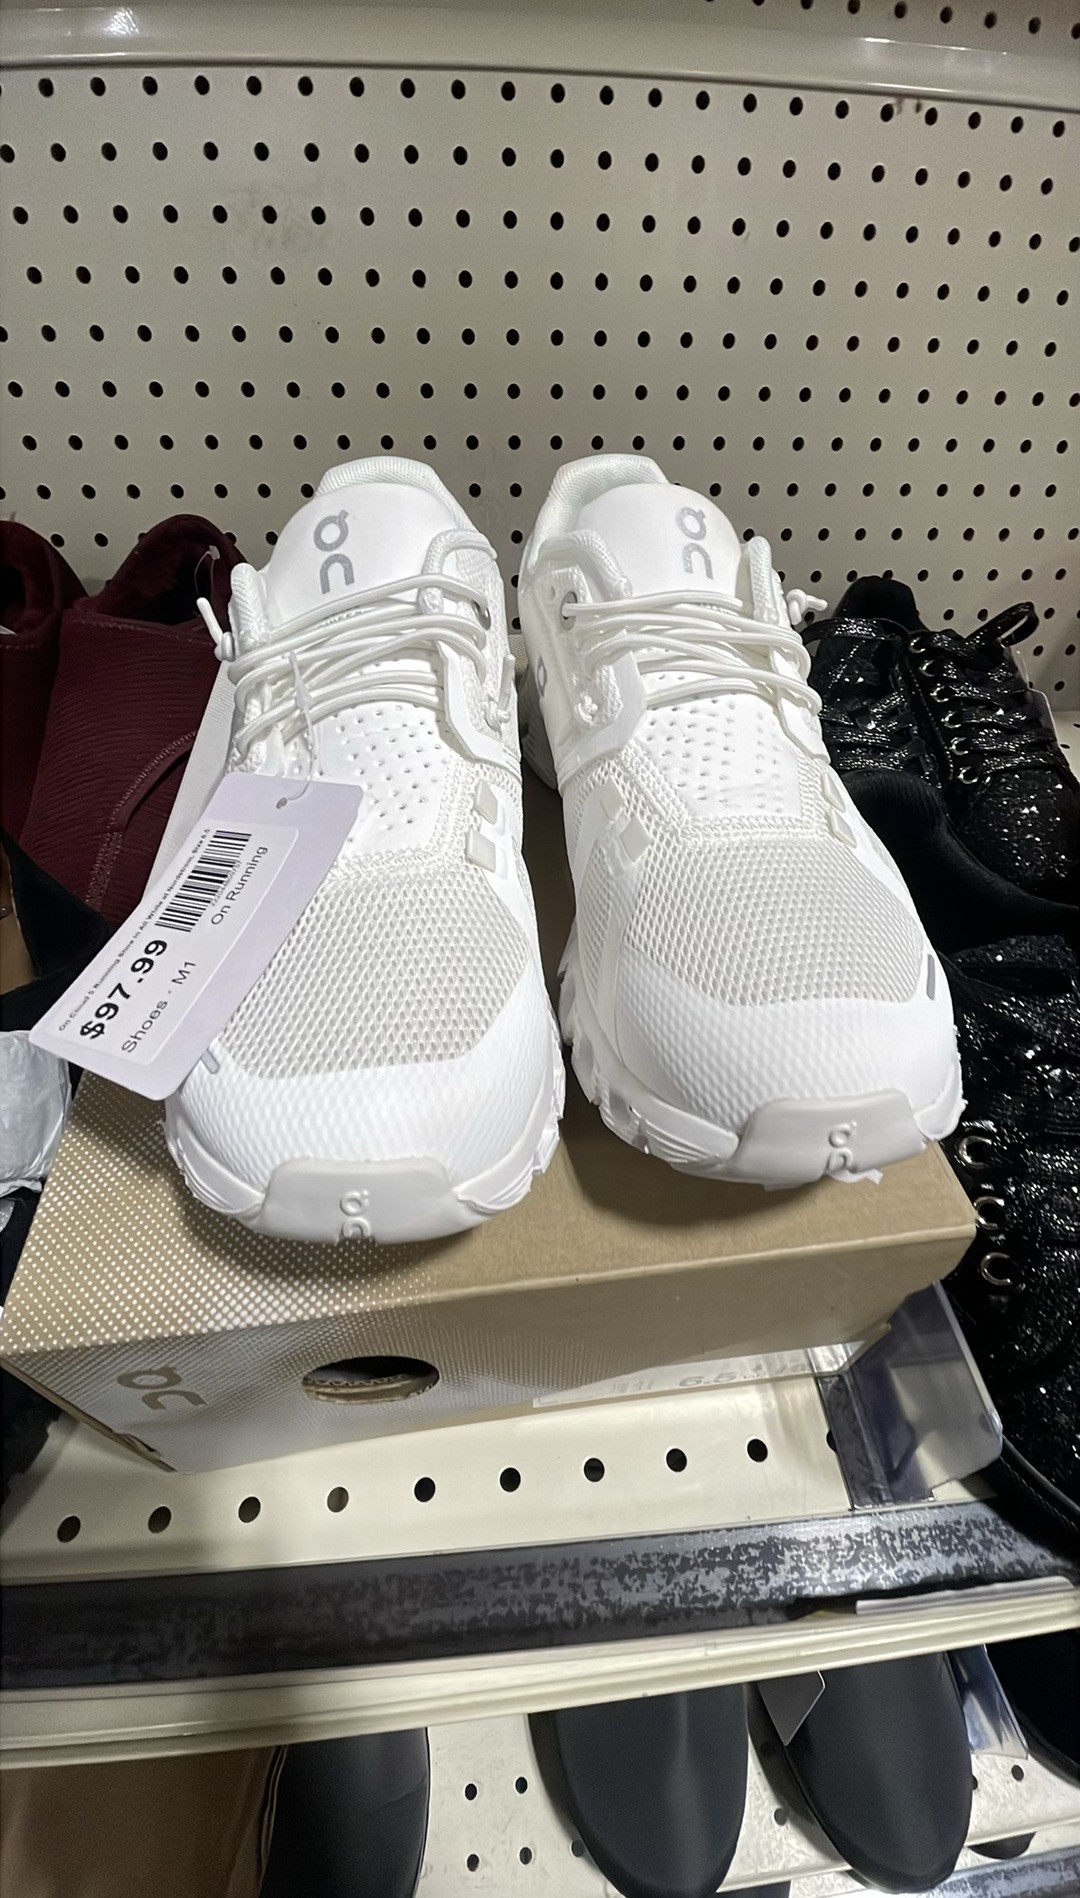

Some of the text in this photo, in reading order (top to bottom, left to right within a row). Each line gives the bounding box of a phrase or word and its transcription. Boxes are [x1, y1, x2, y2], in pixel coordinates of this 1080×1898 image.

[210, 904, 232, 925] On
[225, 846, 268, 901] Running
[59, 1019, 71, 1031] On
[69, 996, 90, 1018] Cloud
[93, 959, 121, 989] Running
[118, 939, 134, 958] Shoe
[139, 919, 149, 931] All
[147, 901, 163, 920] White
[162, 892, 169, 900] at
[192, 839, 204, 854] Size
[79, 939, 168, 1040] $97.99
[121, 1000, 168, 1053] Shoes
[171, 961, 196, 985] M1
[678, 1371, 738, 1388] 6.5
